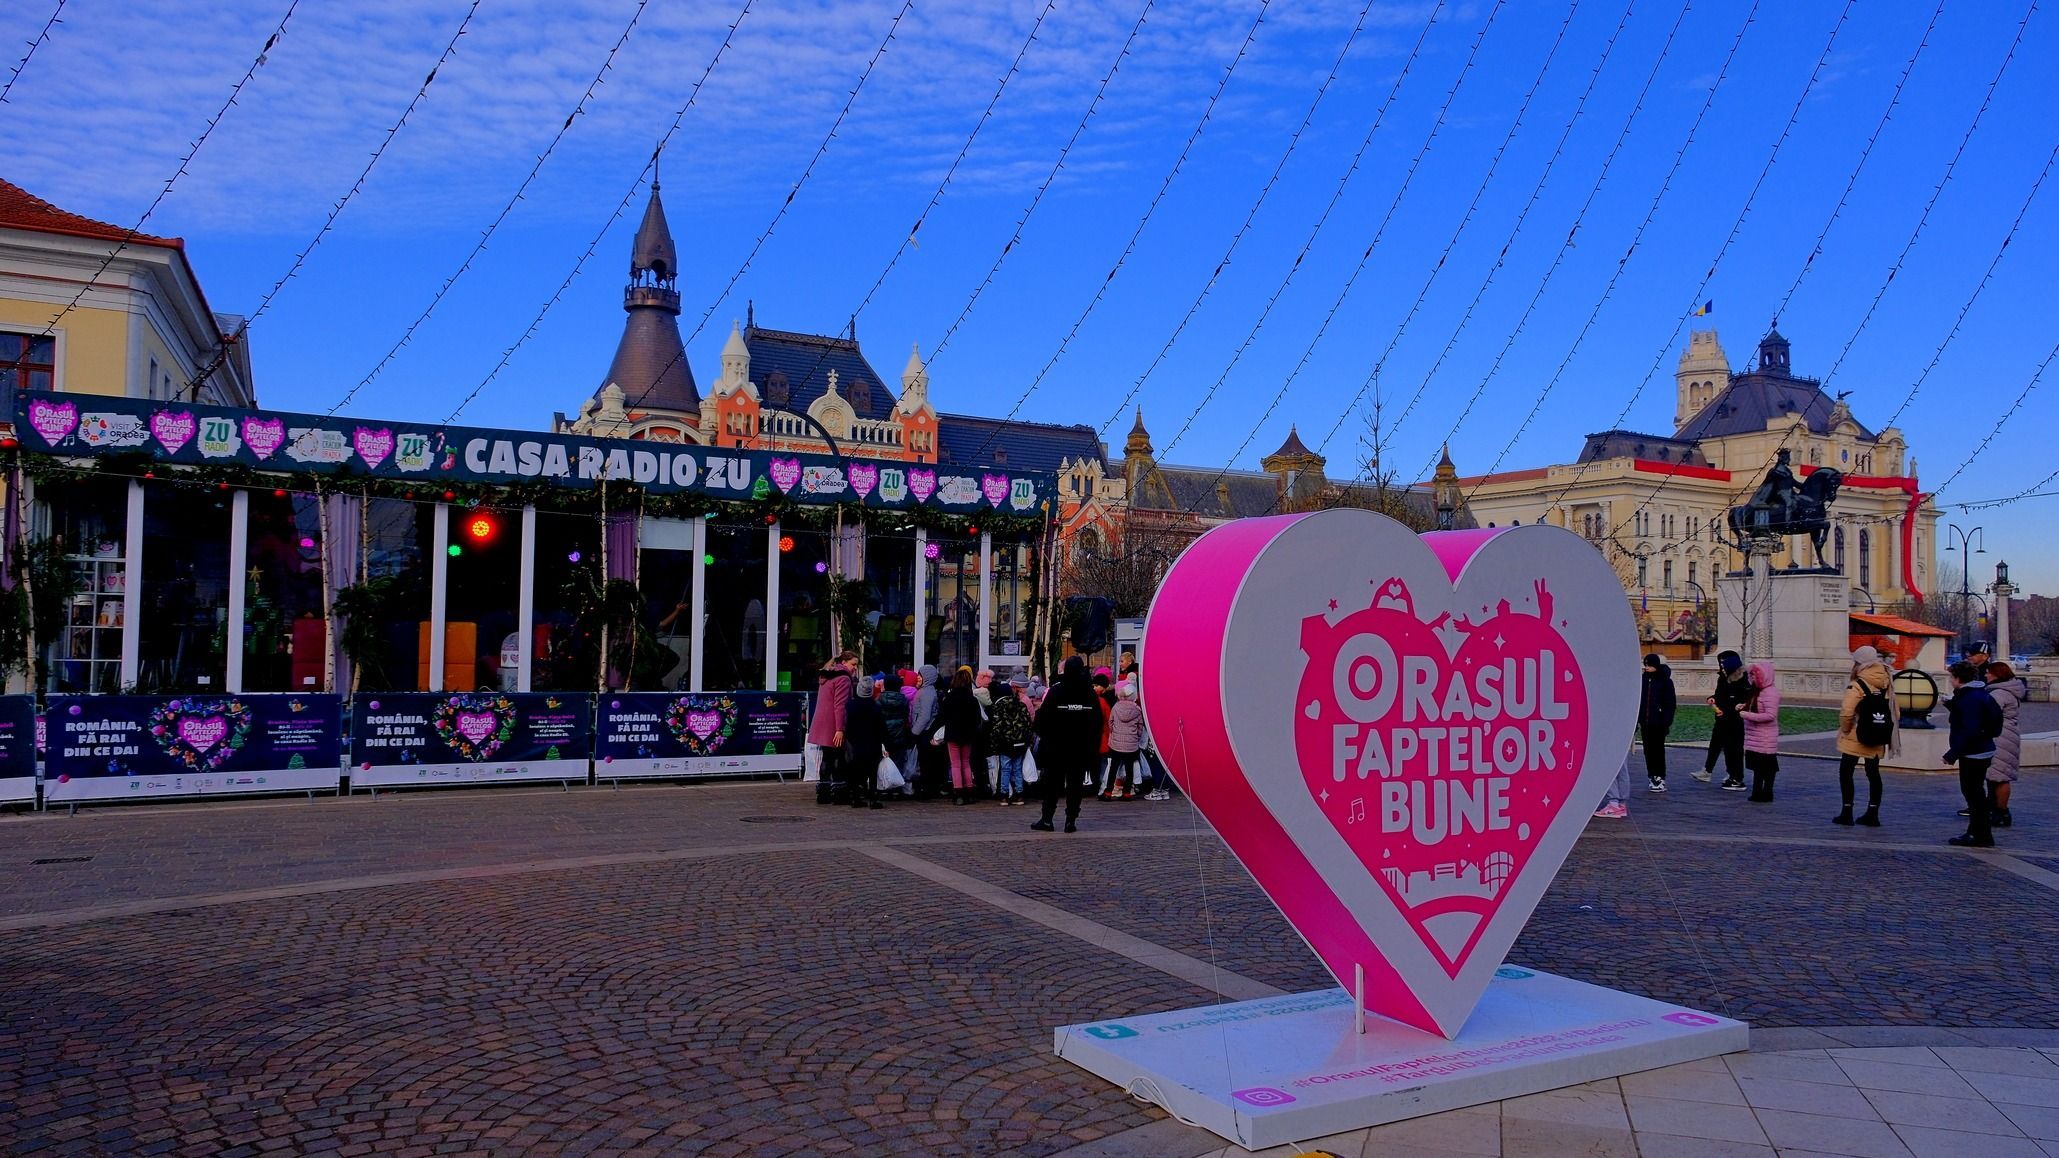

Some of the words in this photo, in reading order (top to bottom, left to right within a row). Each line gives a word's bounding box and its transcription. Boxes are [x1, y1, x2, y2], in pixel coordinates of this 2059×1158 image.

[205, 422, 230, 442] ZU
[205, 443, 229, 452] RADIO
[402, 438, 424, 457] ZU
[465, 438, 570, 478] CASA
[578, 446, 697, 487] RADIO
[706, 456, 751, 490] ZU
[884, 473, 900, 489] ZU
[883, 489, 900, 497] RADIO
[1015, 483, 1029, 498] ZU
[366, 713, 428, 726] ROMÂNIA,
[609, 712, 661, 723] ROMÂNIA,
[65, 718, 142, 732] ROMÂNIA,
[377, 725, 392, 735] FĂ
[393, 726, 415, 735] RAI
[617, 722, 631, 732] FĂ
[632, 724, 650, 732] RAI
[78, 732, 97, 744] FĂ
[99, 734, 126, 743] RAI
[365, 738, 387, 747] DIN
[389, 738, 403, 747] CE
[404, 737, 425, 746] DAI
[608, 734, 626, 742] DIN
[628, 734, 640, 742] CE
[641, 733, 659, 742] DAI
[63, 747, 91, 757] DIN
[93, 746, 111, 756] CE
[113, 745, 139, 755] DAI
[1332, 720, 1556, 782] FAPTELOR
[1381, 777, 1511, 846] BUNE
